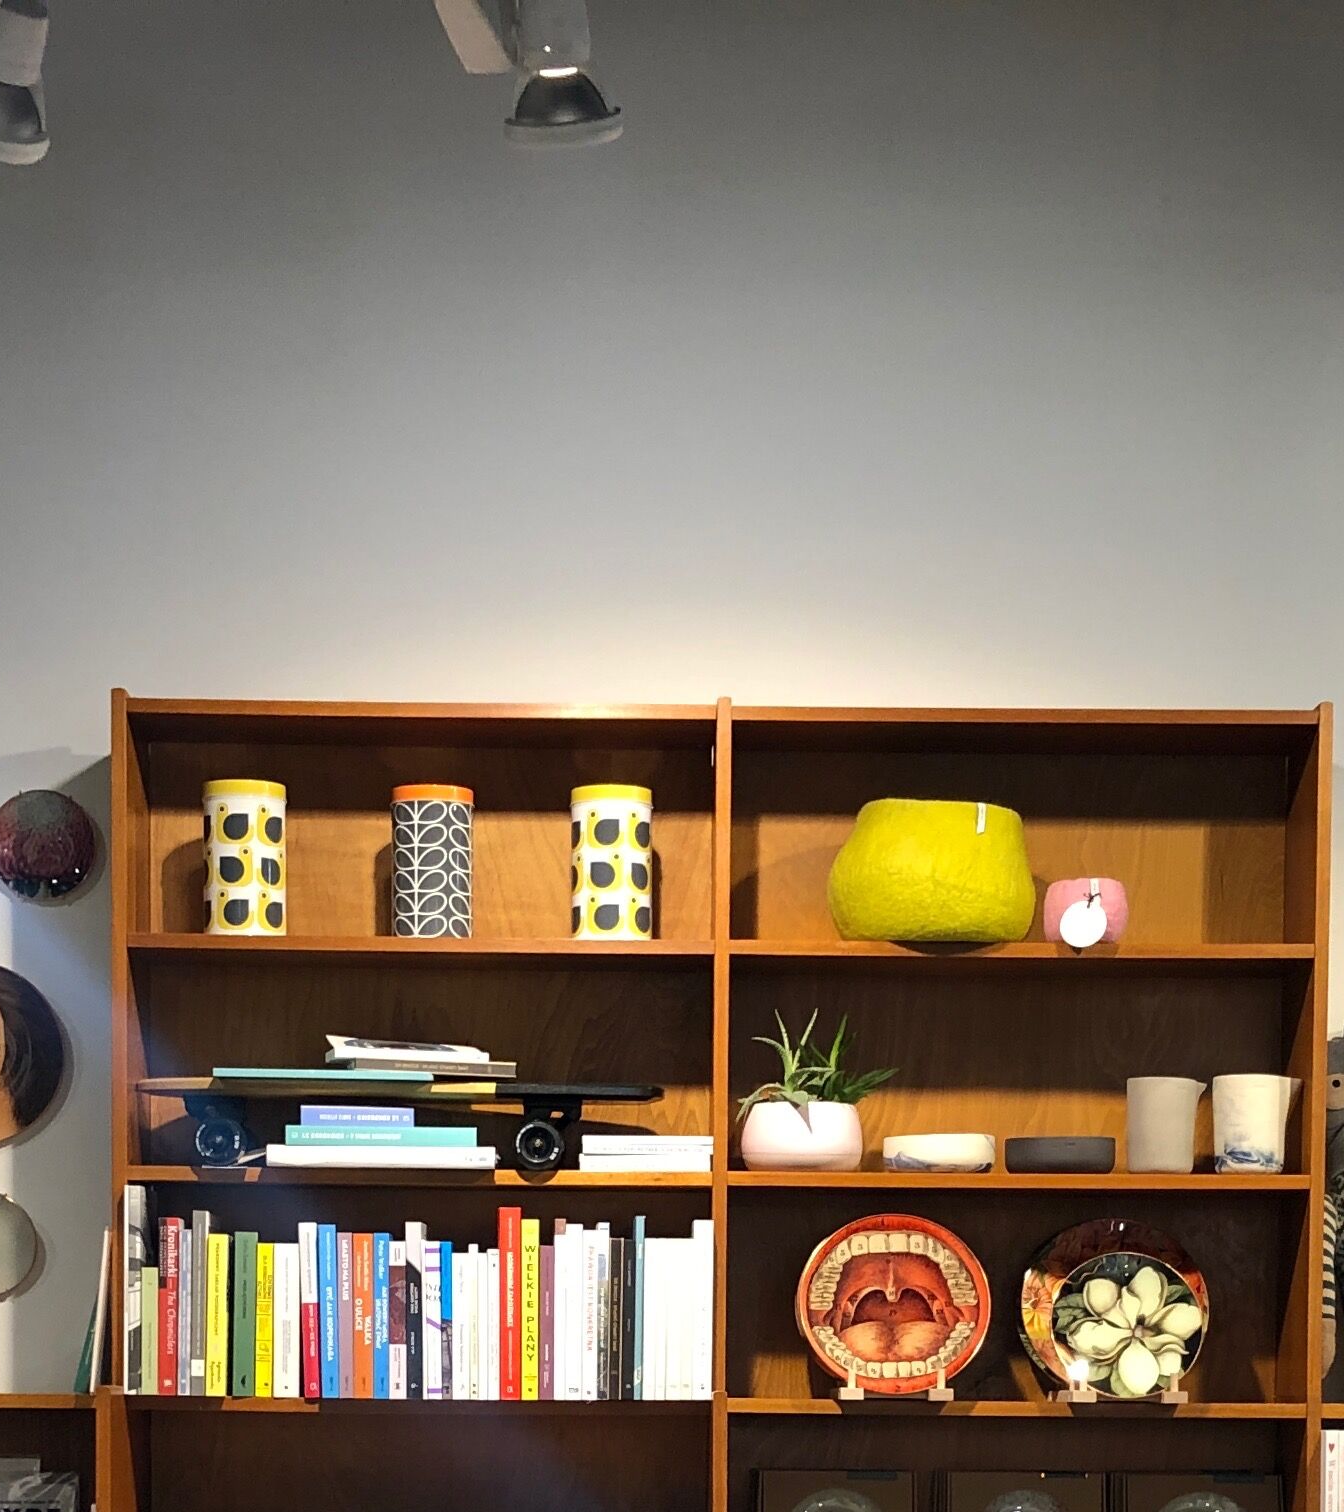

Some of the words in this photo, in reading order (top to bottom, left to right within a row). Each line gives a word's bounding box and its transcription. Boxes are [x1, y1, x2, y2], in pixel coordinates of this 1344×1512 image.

[167, 1225, 178, 1277] Kronikarki
[167, 1291, 176, 1306] The
[525, 1245, 536, 1309] WIELKIE
[167, 1308, 176, 1354] Chroniclers
[364, 1315, 372, 1344] WALKA
[526, 1316, 536, 1361] PLANY
